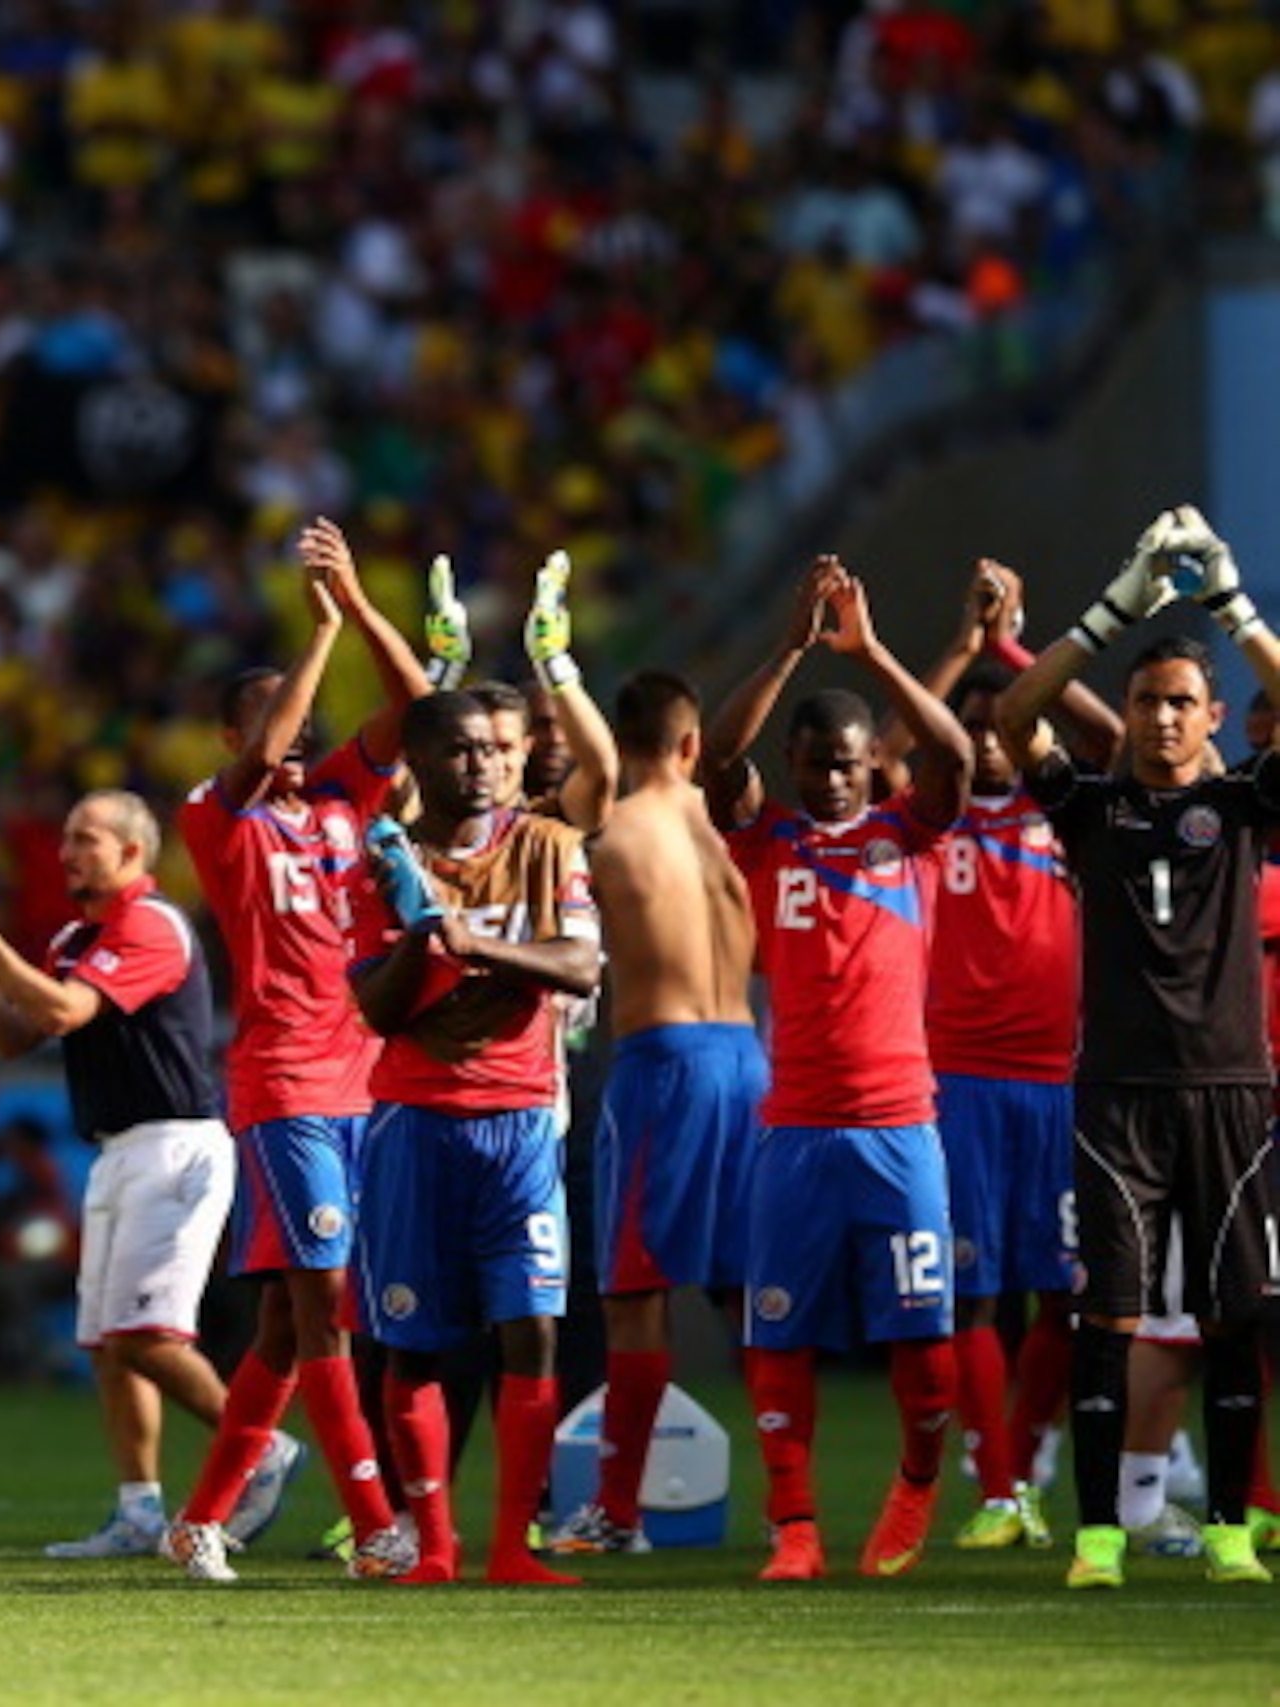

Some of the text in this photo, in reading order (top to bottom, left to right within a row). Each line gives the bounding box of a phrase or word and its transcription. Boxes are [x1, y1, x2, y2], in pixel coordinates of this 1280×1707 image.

[267, 852, 320, 914] 15
[945, 836, 979, 895] 8
[1149, 859, 1173, 925] 1
[775, 866, 818, 931] 12
[524, 1212, 565, 1271] 9
[890, 1231, 945, 1296] 12
